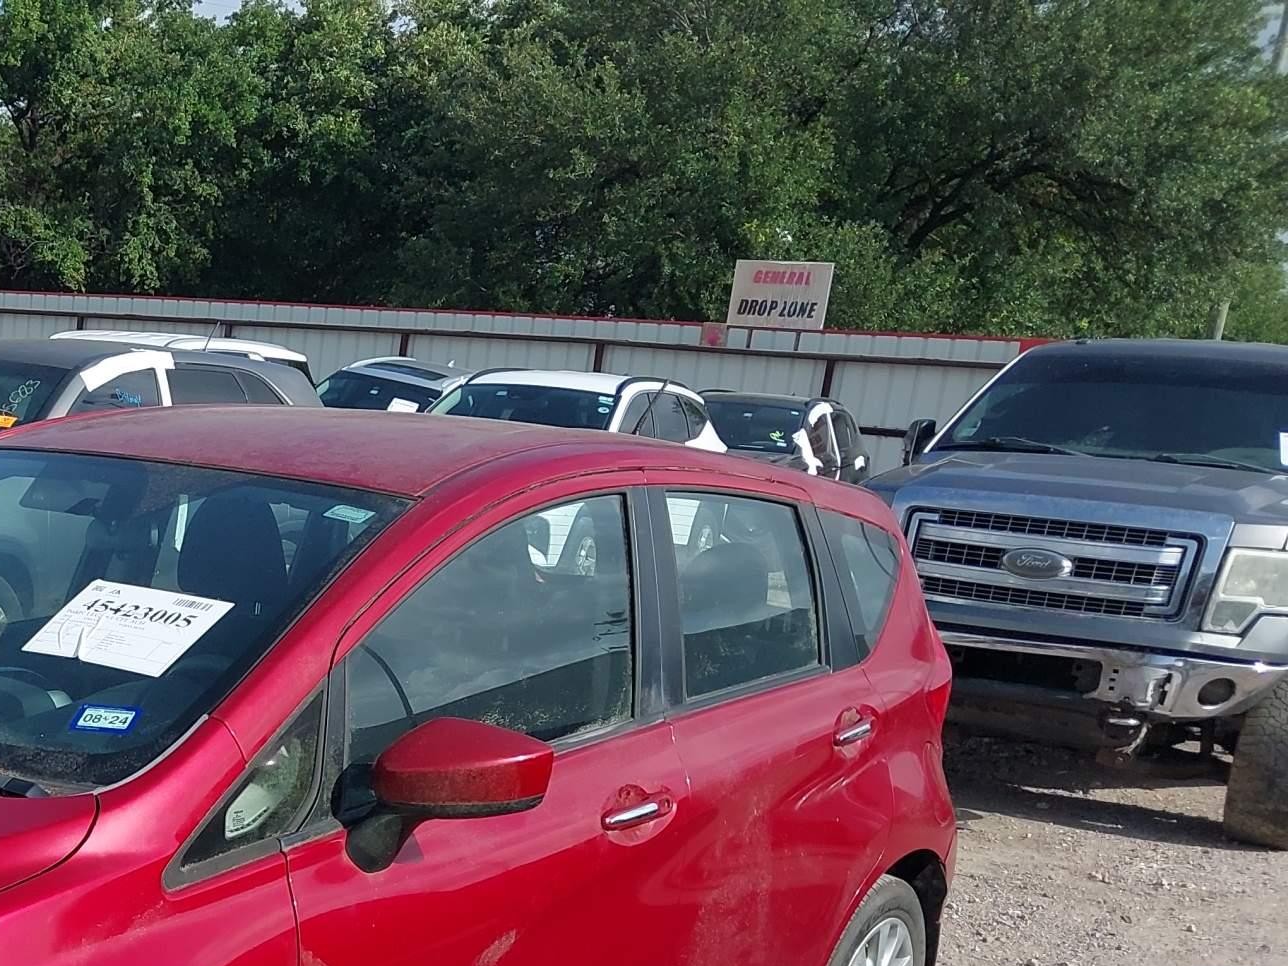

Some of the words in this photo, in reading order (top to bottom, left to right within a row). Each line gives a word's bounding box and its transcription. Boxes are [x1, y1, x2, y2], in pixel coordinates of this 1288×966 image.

[753, 269, 811, 286] GENERAL
[737, 299, 778, 316] DROP
[1016, 553, 1052, 568] Ford
[83, 599, 199, 628] 45423005
[83, 713, 103, 724] 08
[108, 715, 130, 726] 24
